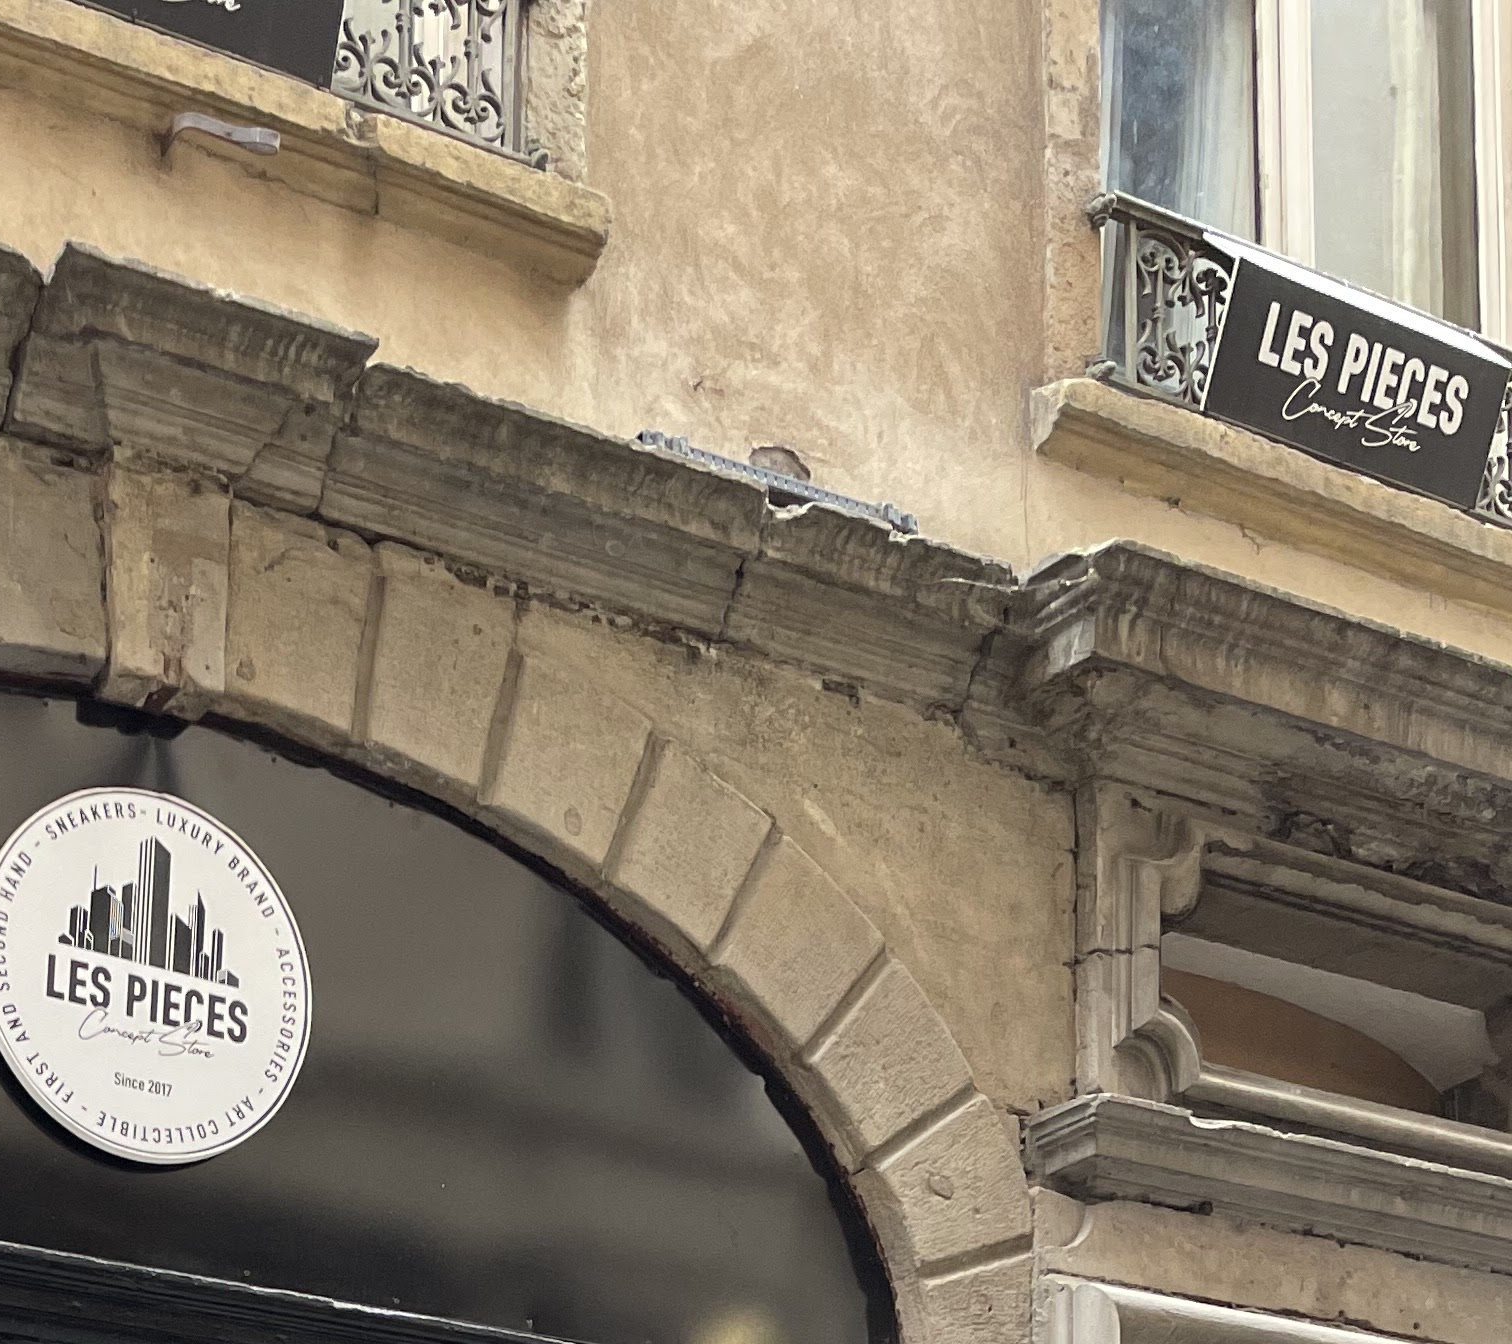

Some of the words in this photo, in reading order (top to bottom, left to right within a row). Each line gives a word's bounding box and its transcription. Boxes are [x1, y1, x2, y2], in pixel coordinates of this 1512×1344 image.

[1257, 300, 1335, 381] LES
[1337, 332, 1470, 437] PIECES
[1282, 377, 1368, 429] Concept
[1361, 402, 1421, 453] Store
[0, 850, 34, 904] HAND
[156, 807, 225, 856] LUXURY
[227, 855, 276, 920] BRAND
[2, 1004, 31, 1044] AND
[45, 953, 113, 1011] LES
[126, 973, 250, 1045] PIECES
[264, 946, 299, 1084] ACCESSORIES
[78, 1007, 153, 1046] Concept
[157, 1021, 215, 1059] Store
[26, 1052, 76, 1105] FIRST
[113, 1071, 145, 1092] Since
[147, 1079, 173, 1098] 2017
[96, 1110, 221, 1146] COLLECTIBLE
[226, 1096, 256, 1128] ART
